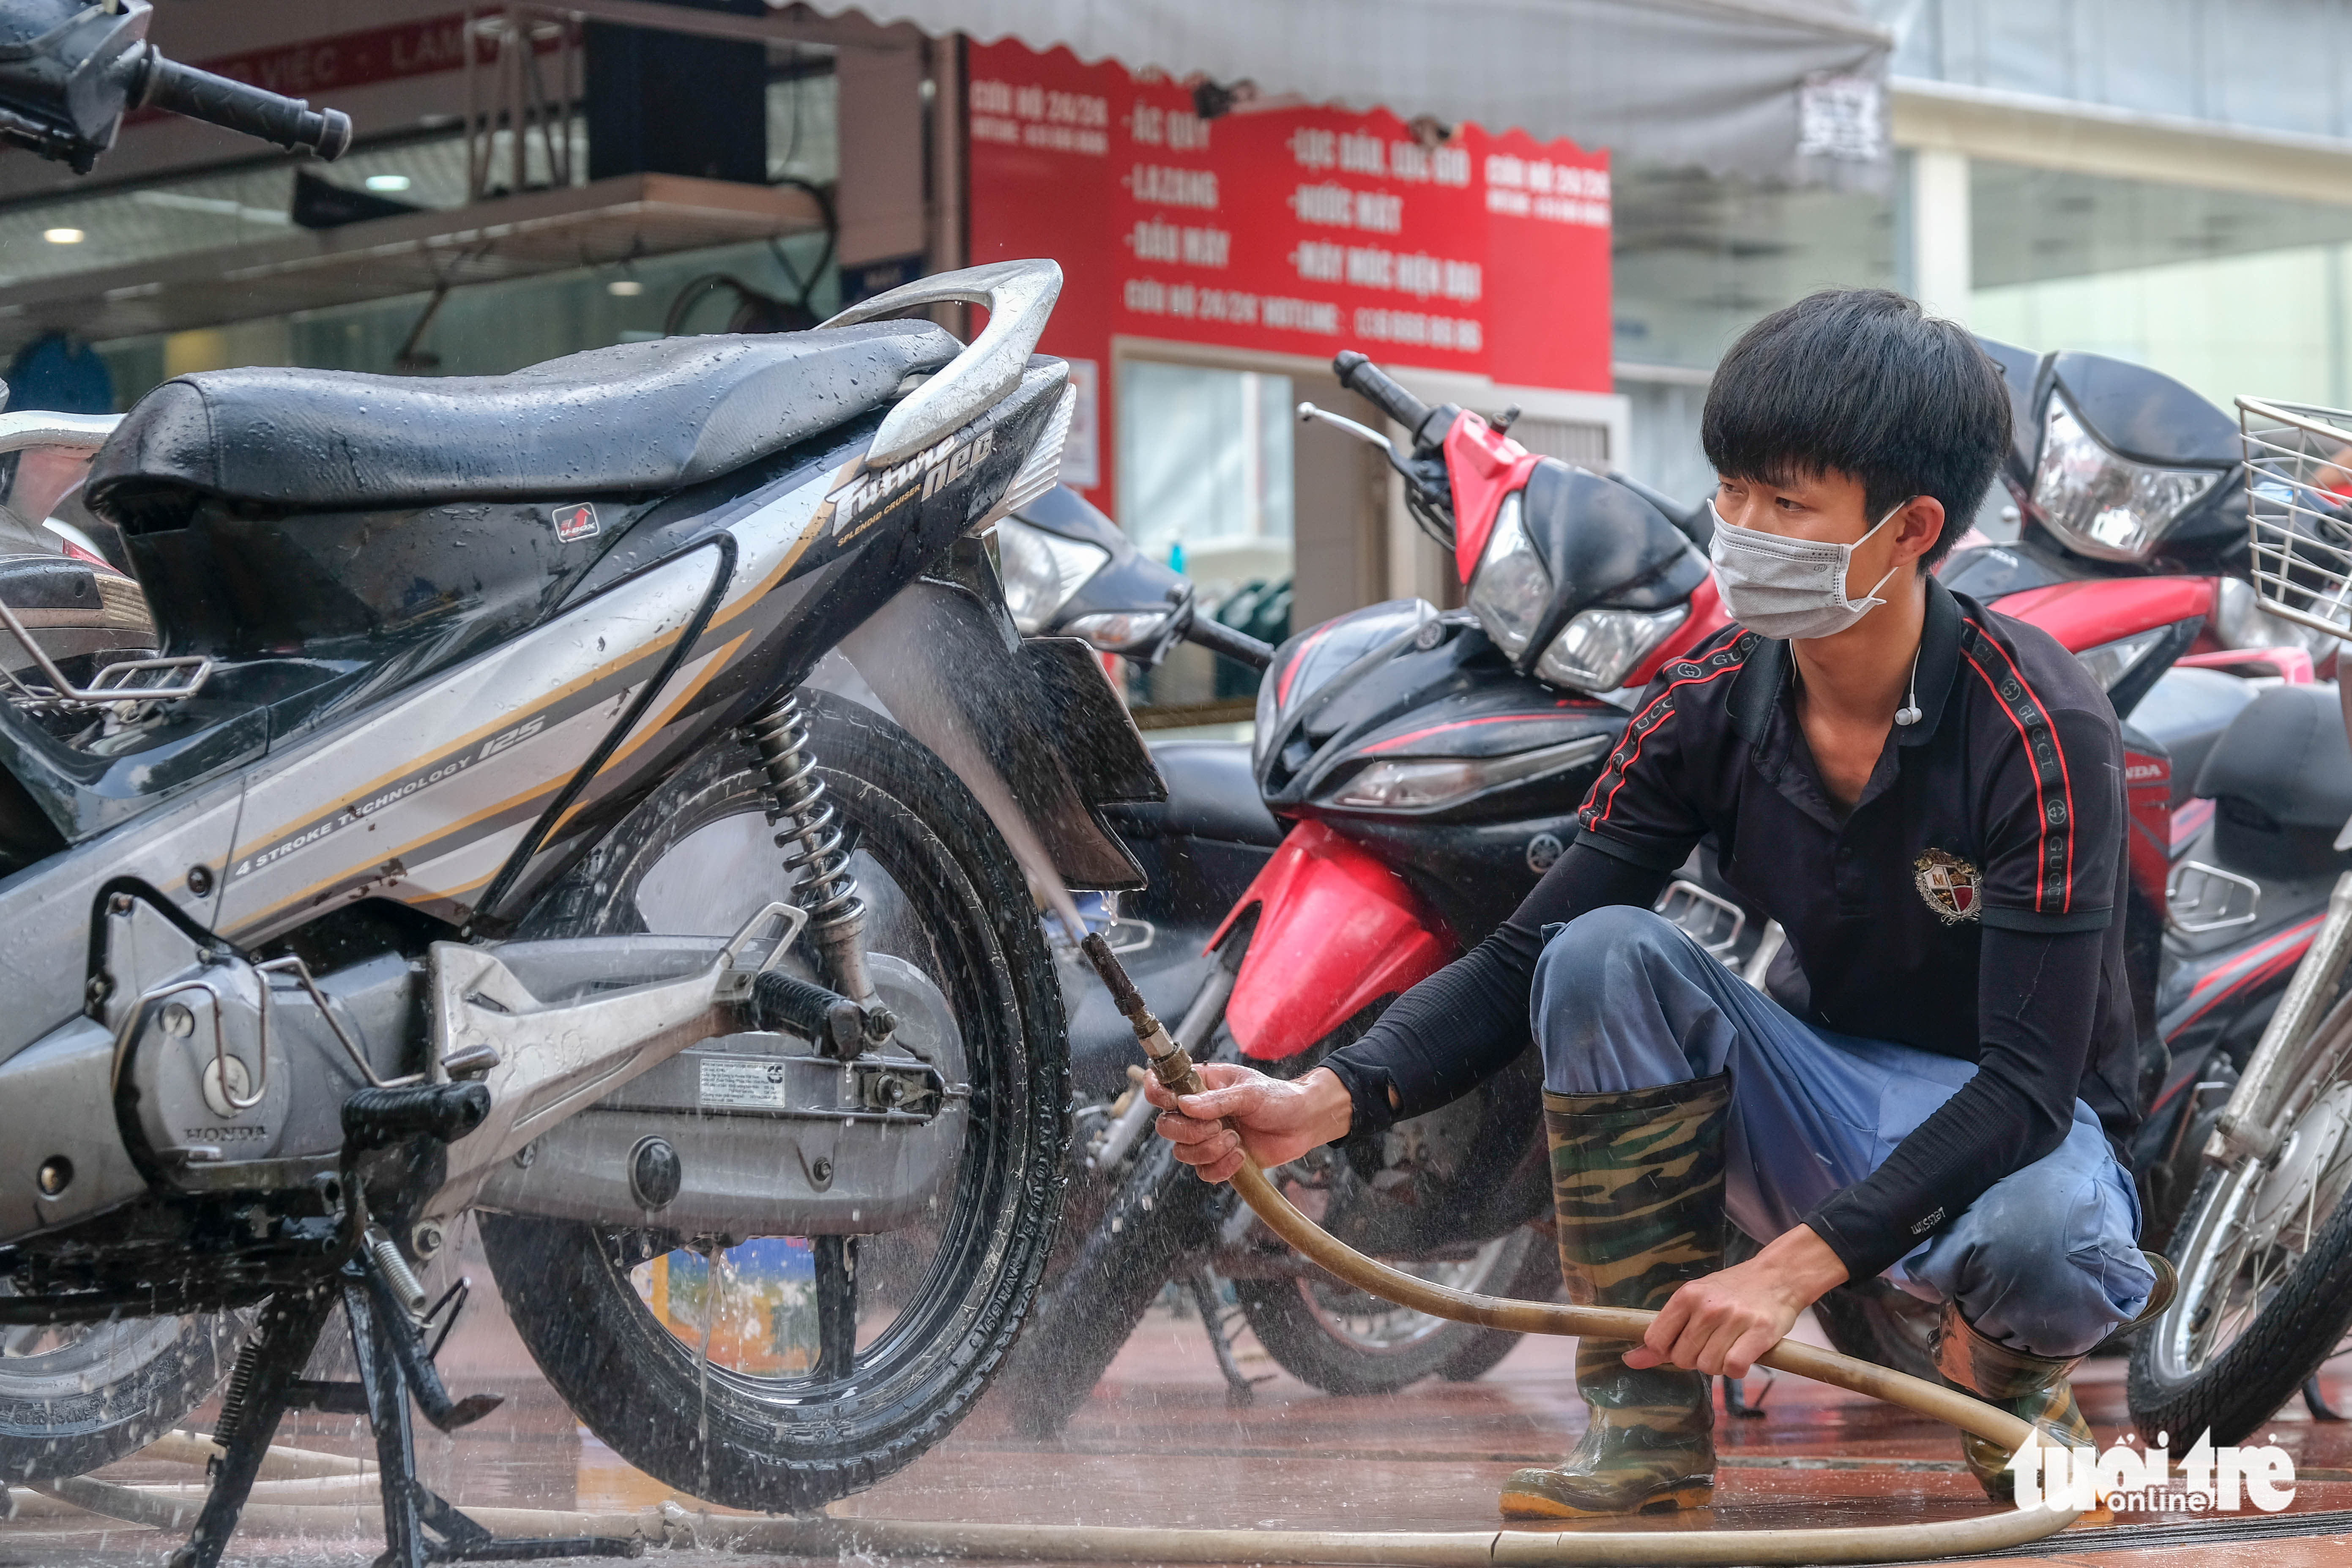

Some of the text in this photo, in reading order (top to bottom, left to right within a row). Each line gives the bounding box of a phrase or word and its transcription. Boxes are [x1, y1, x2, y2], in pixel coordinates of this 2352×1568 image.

[826, 435, 960, 536] Future
[837, 483, 921, 547] SPLENDID CRUISER
[561, 522, 595, 536] U-BOX
[2018, 704, 2054, 769] GUCCI
[235, 860, 252, 876] 4
[255, 823, 333, 868] STROKE
[477, 715, 546, 760] 125
[2047, 835, 2063, 909] GUCCI
[184, 1125, 268, 1141] HONDA
